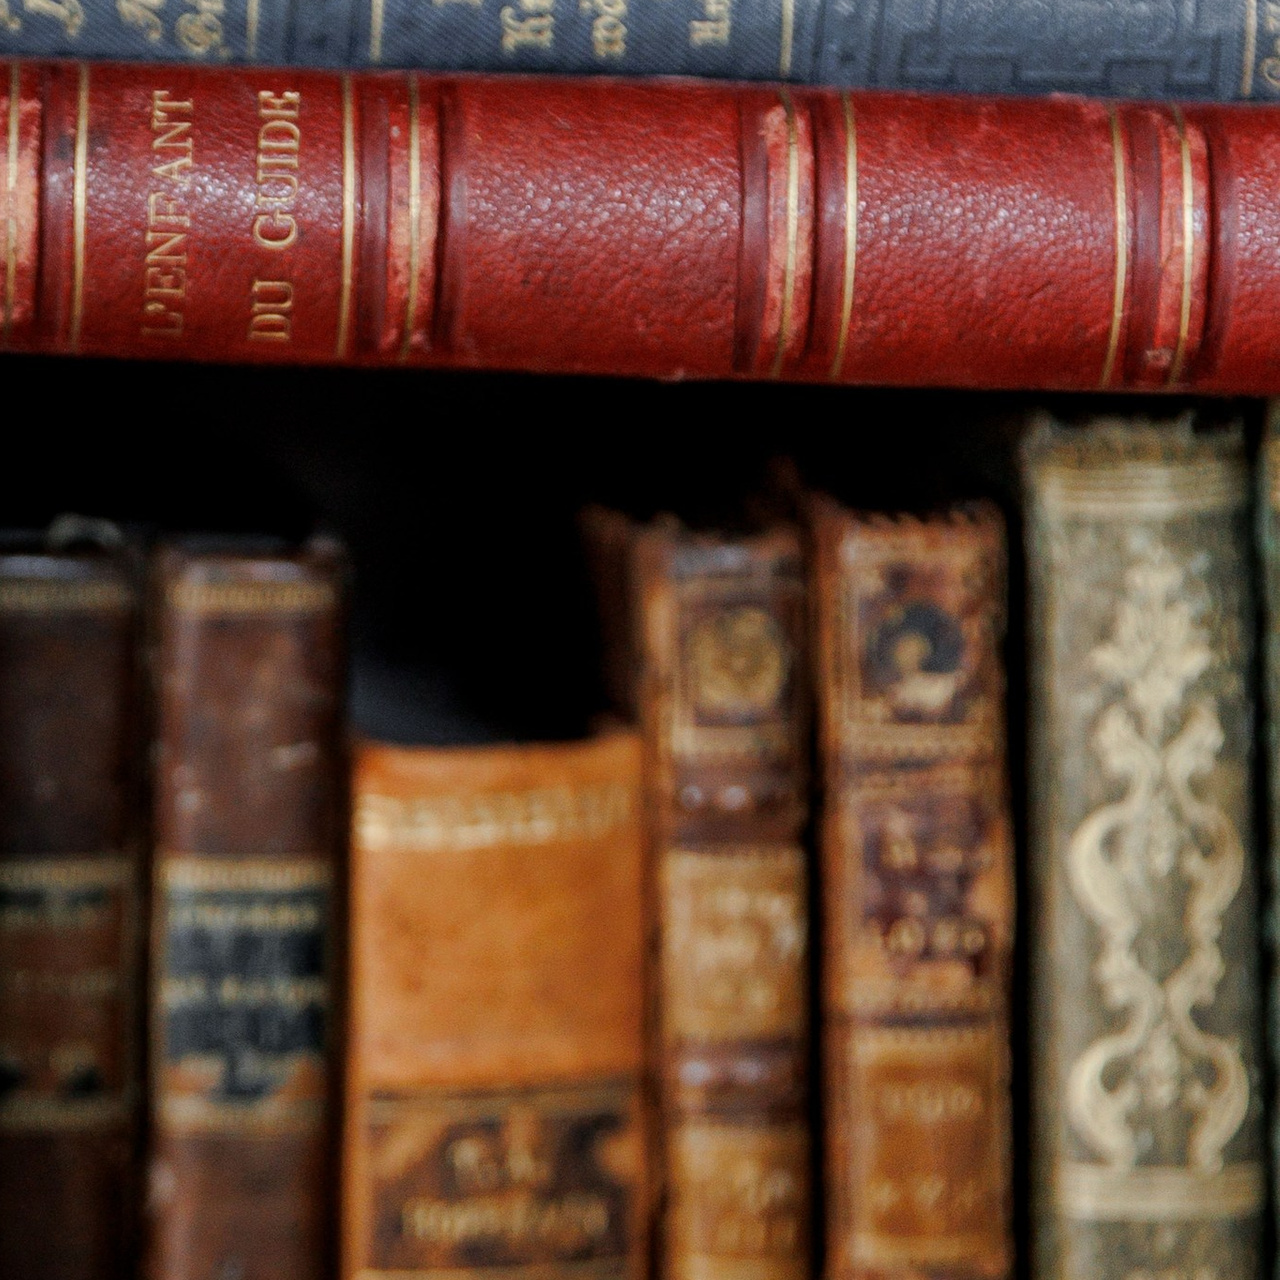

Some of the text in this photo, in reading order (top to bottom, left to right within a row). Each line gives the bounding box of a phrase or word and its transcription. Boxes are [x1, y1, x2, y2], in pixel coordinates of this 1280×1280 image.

[141, 89, 195, 339] L'ENFANT
[247, 89, 303, 343] DU GUIDE
